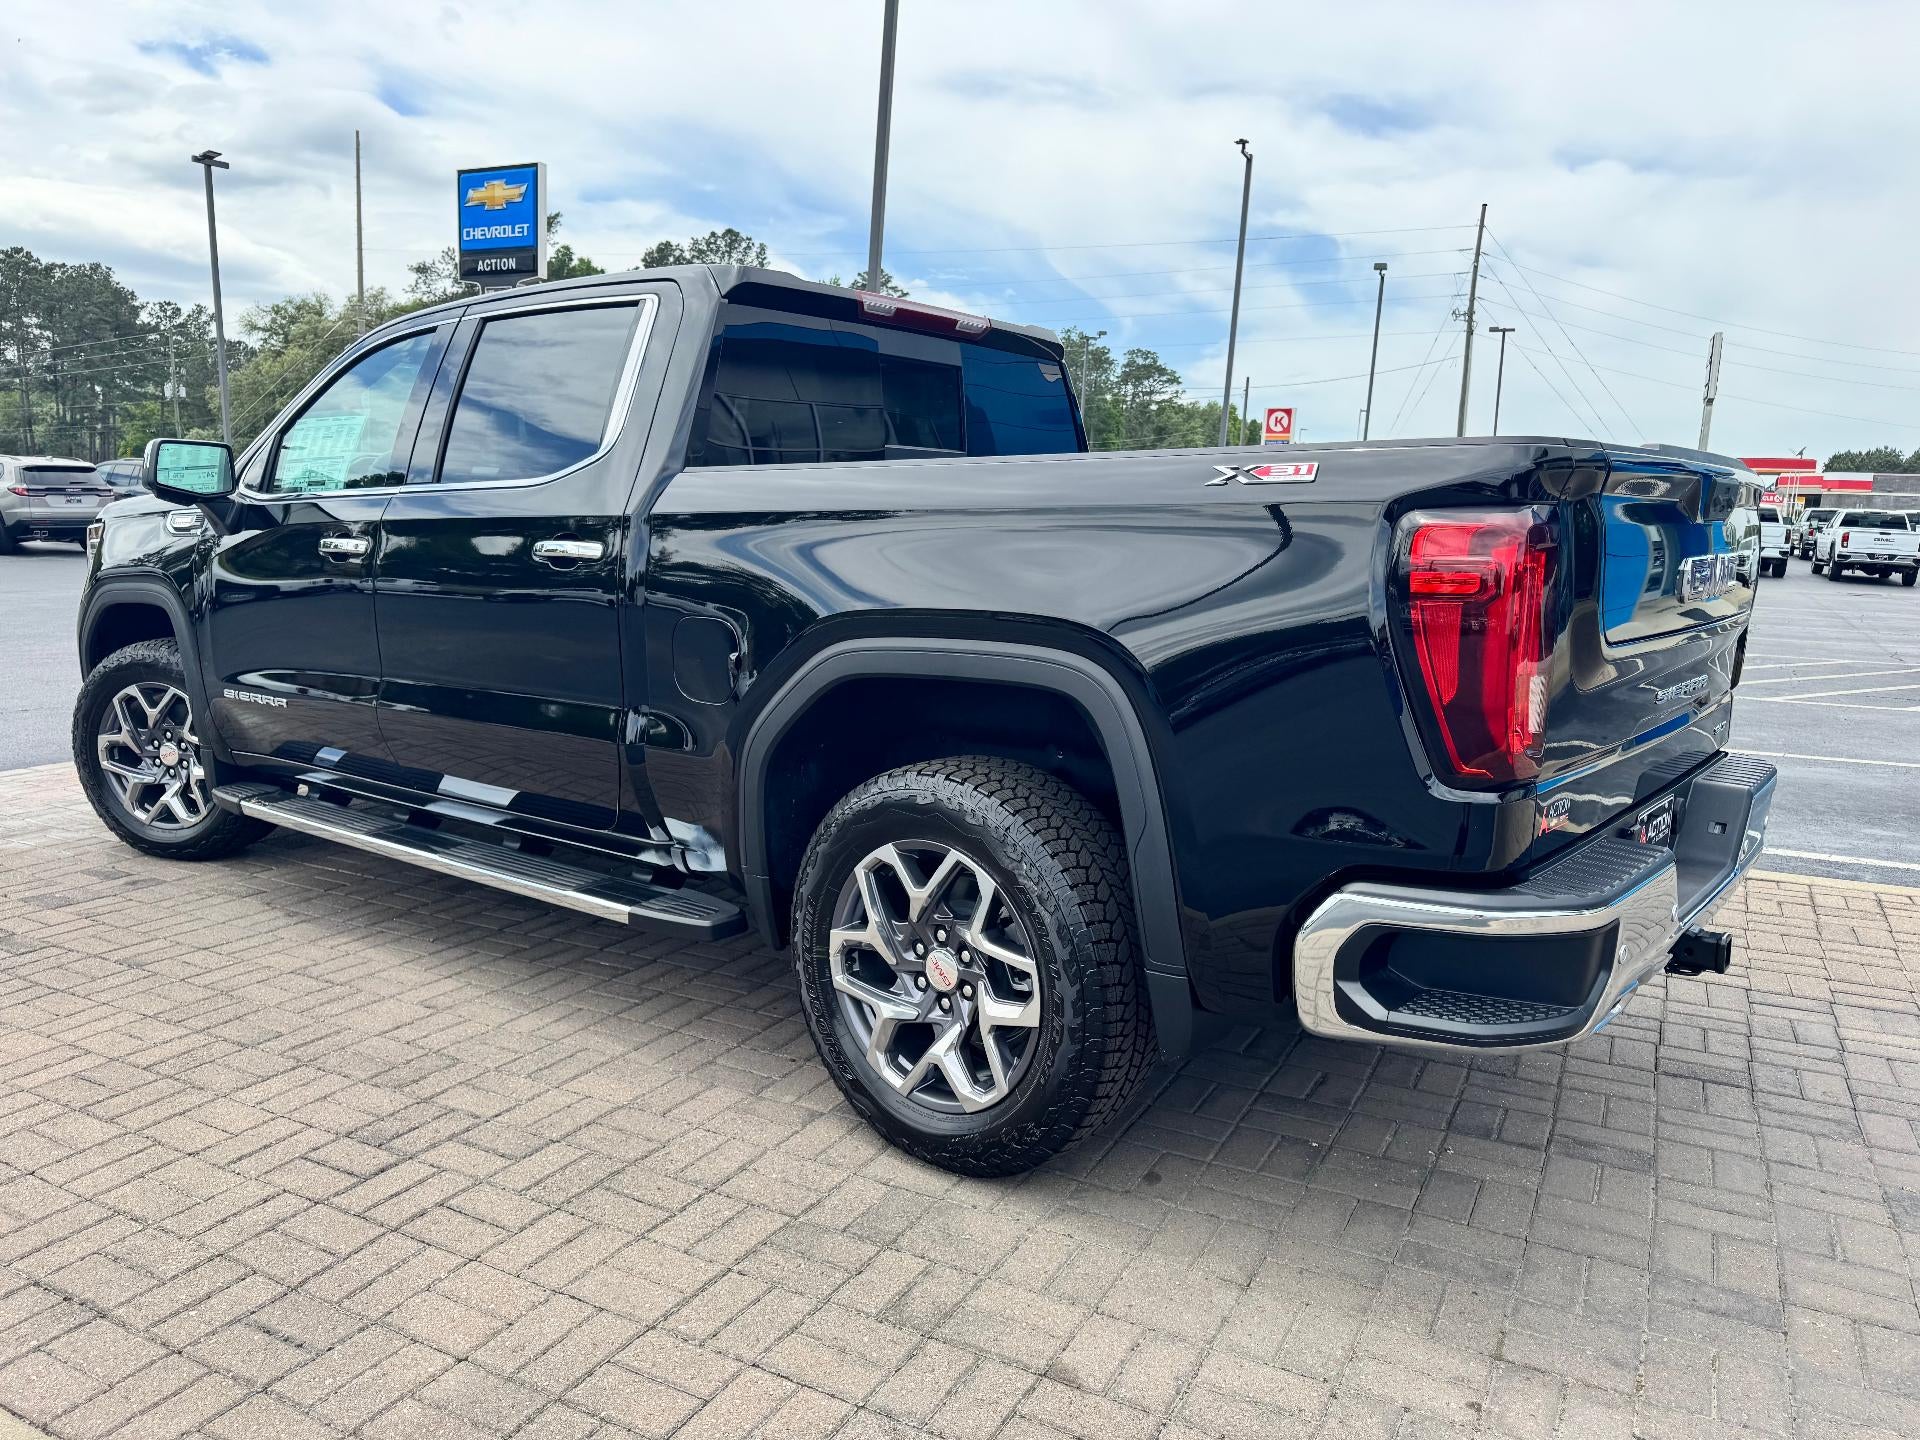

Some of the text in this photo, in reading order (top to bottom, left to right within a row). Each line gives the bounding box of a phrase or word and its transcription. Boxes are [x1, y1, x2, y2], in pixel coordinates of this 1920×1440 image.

[463, 224, 530, 241] CHEVROLET
[477, 258, 516, 272] ACTION
[1204, 462, 1319, 486] X31
[224, 689, 288, 708] SIERRA
[1656, 674, 1708, 704] SIERRA
[1647, 810, 1672, 841] ACTION
